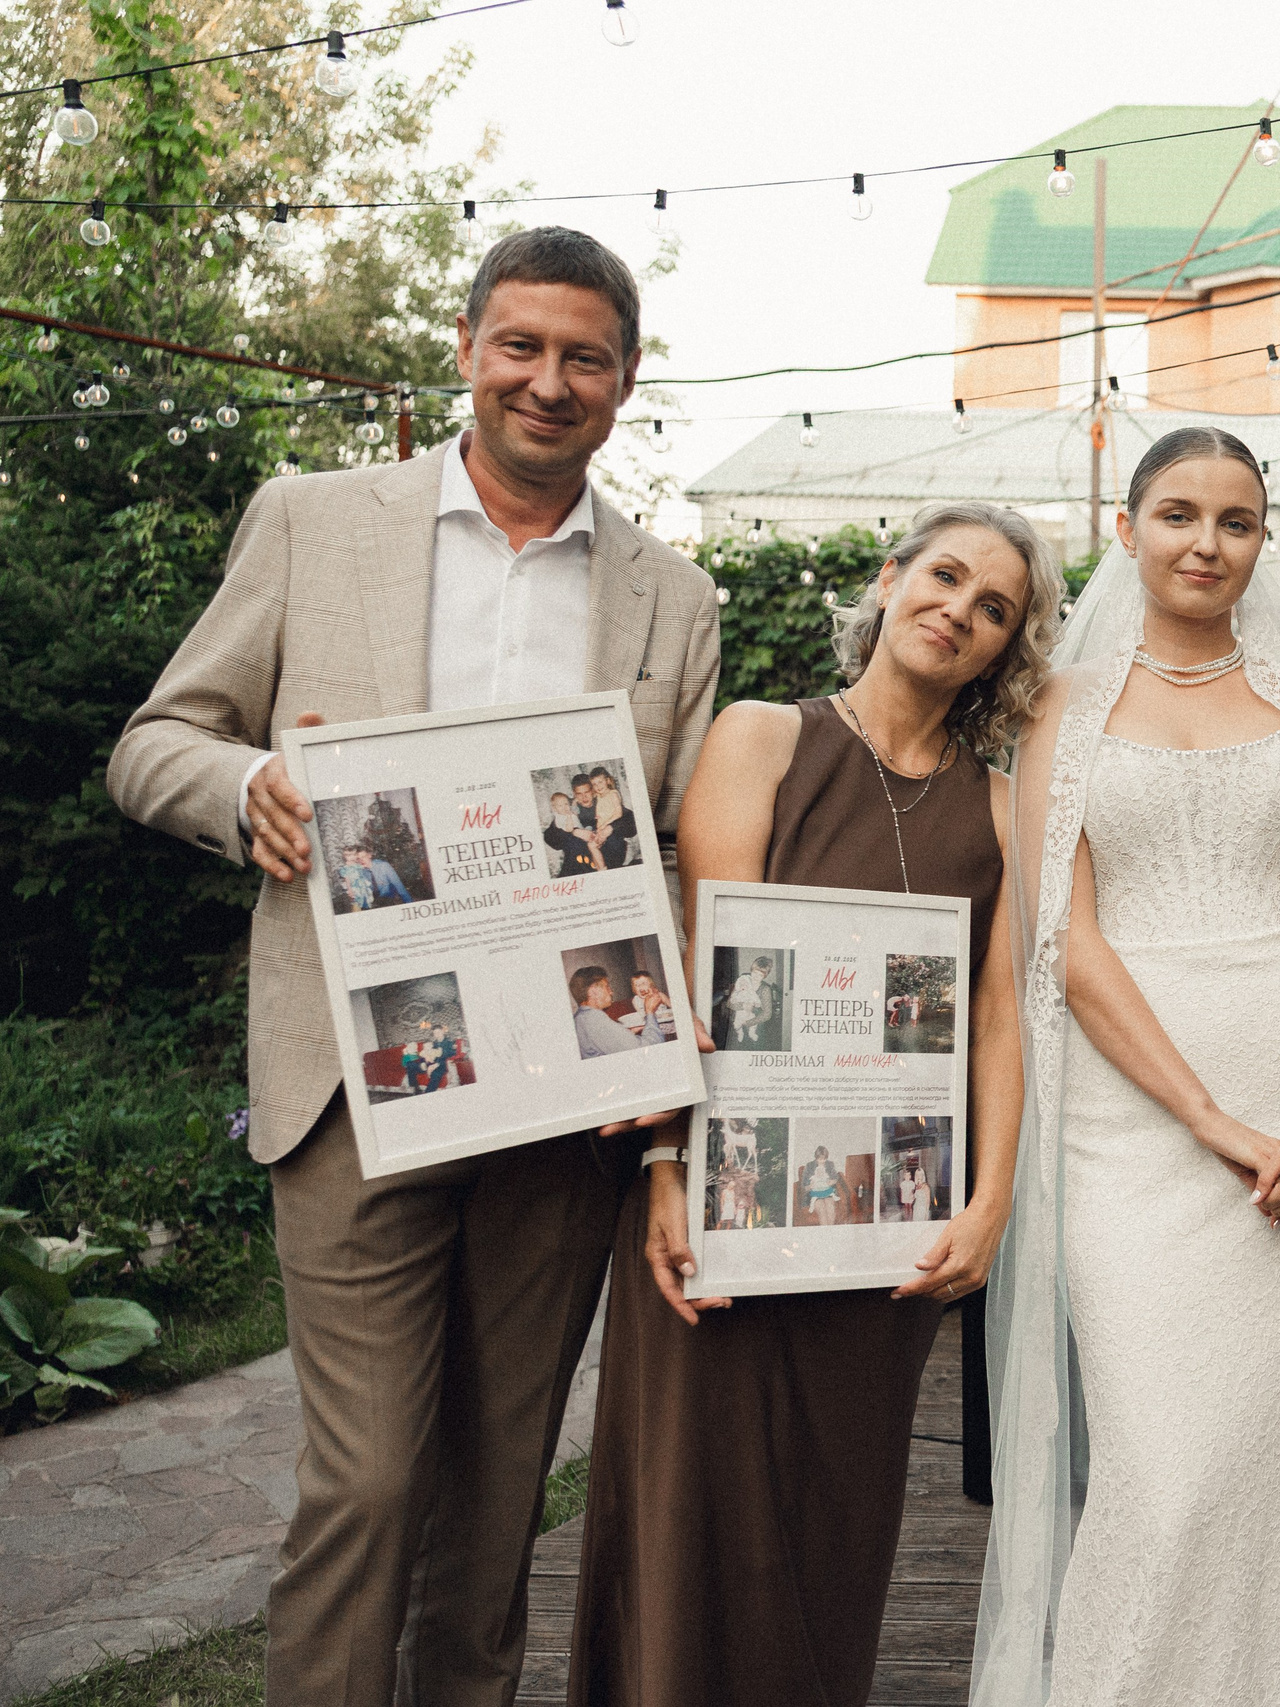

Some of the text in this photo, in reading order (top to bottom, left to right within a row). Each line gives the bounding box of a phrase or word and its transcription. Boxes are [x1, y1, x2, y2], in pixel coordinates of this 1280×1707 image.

[439, 834, 534, 864] ТЕПЕРЬ
[443, 855, 536, 884] ЖЕНАТЫ
[399, 878, 585, 921] ЛЮБИМЫЙ ПАПОЧКА!
[800, 998, 874, 1018] ТЕПЕРЬ
[800, 1019, 873, 1035] ЖЕНАТЫ
[749, 1053, 898, 1068] ЛЮБИМАЯ МАМОЧКА!
